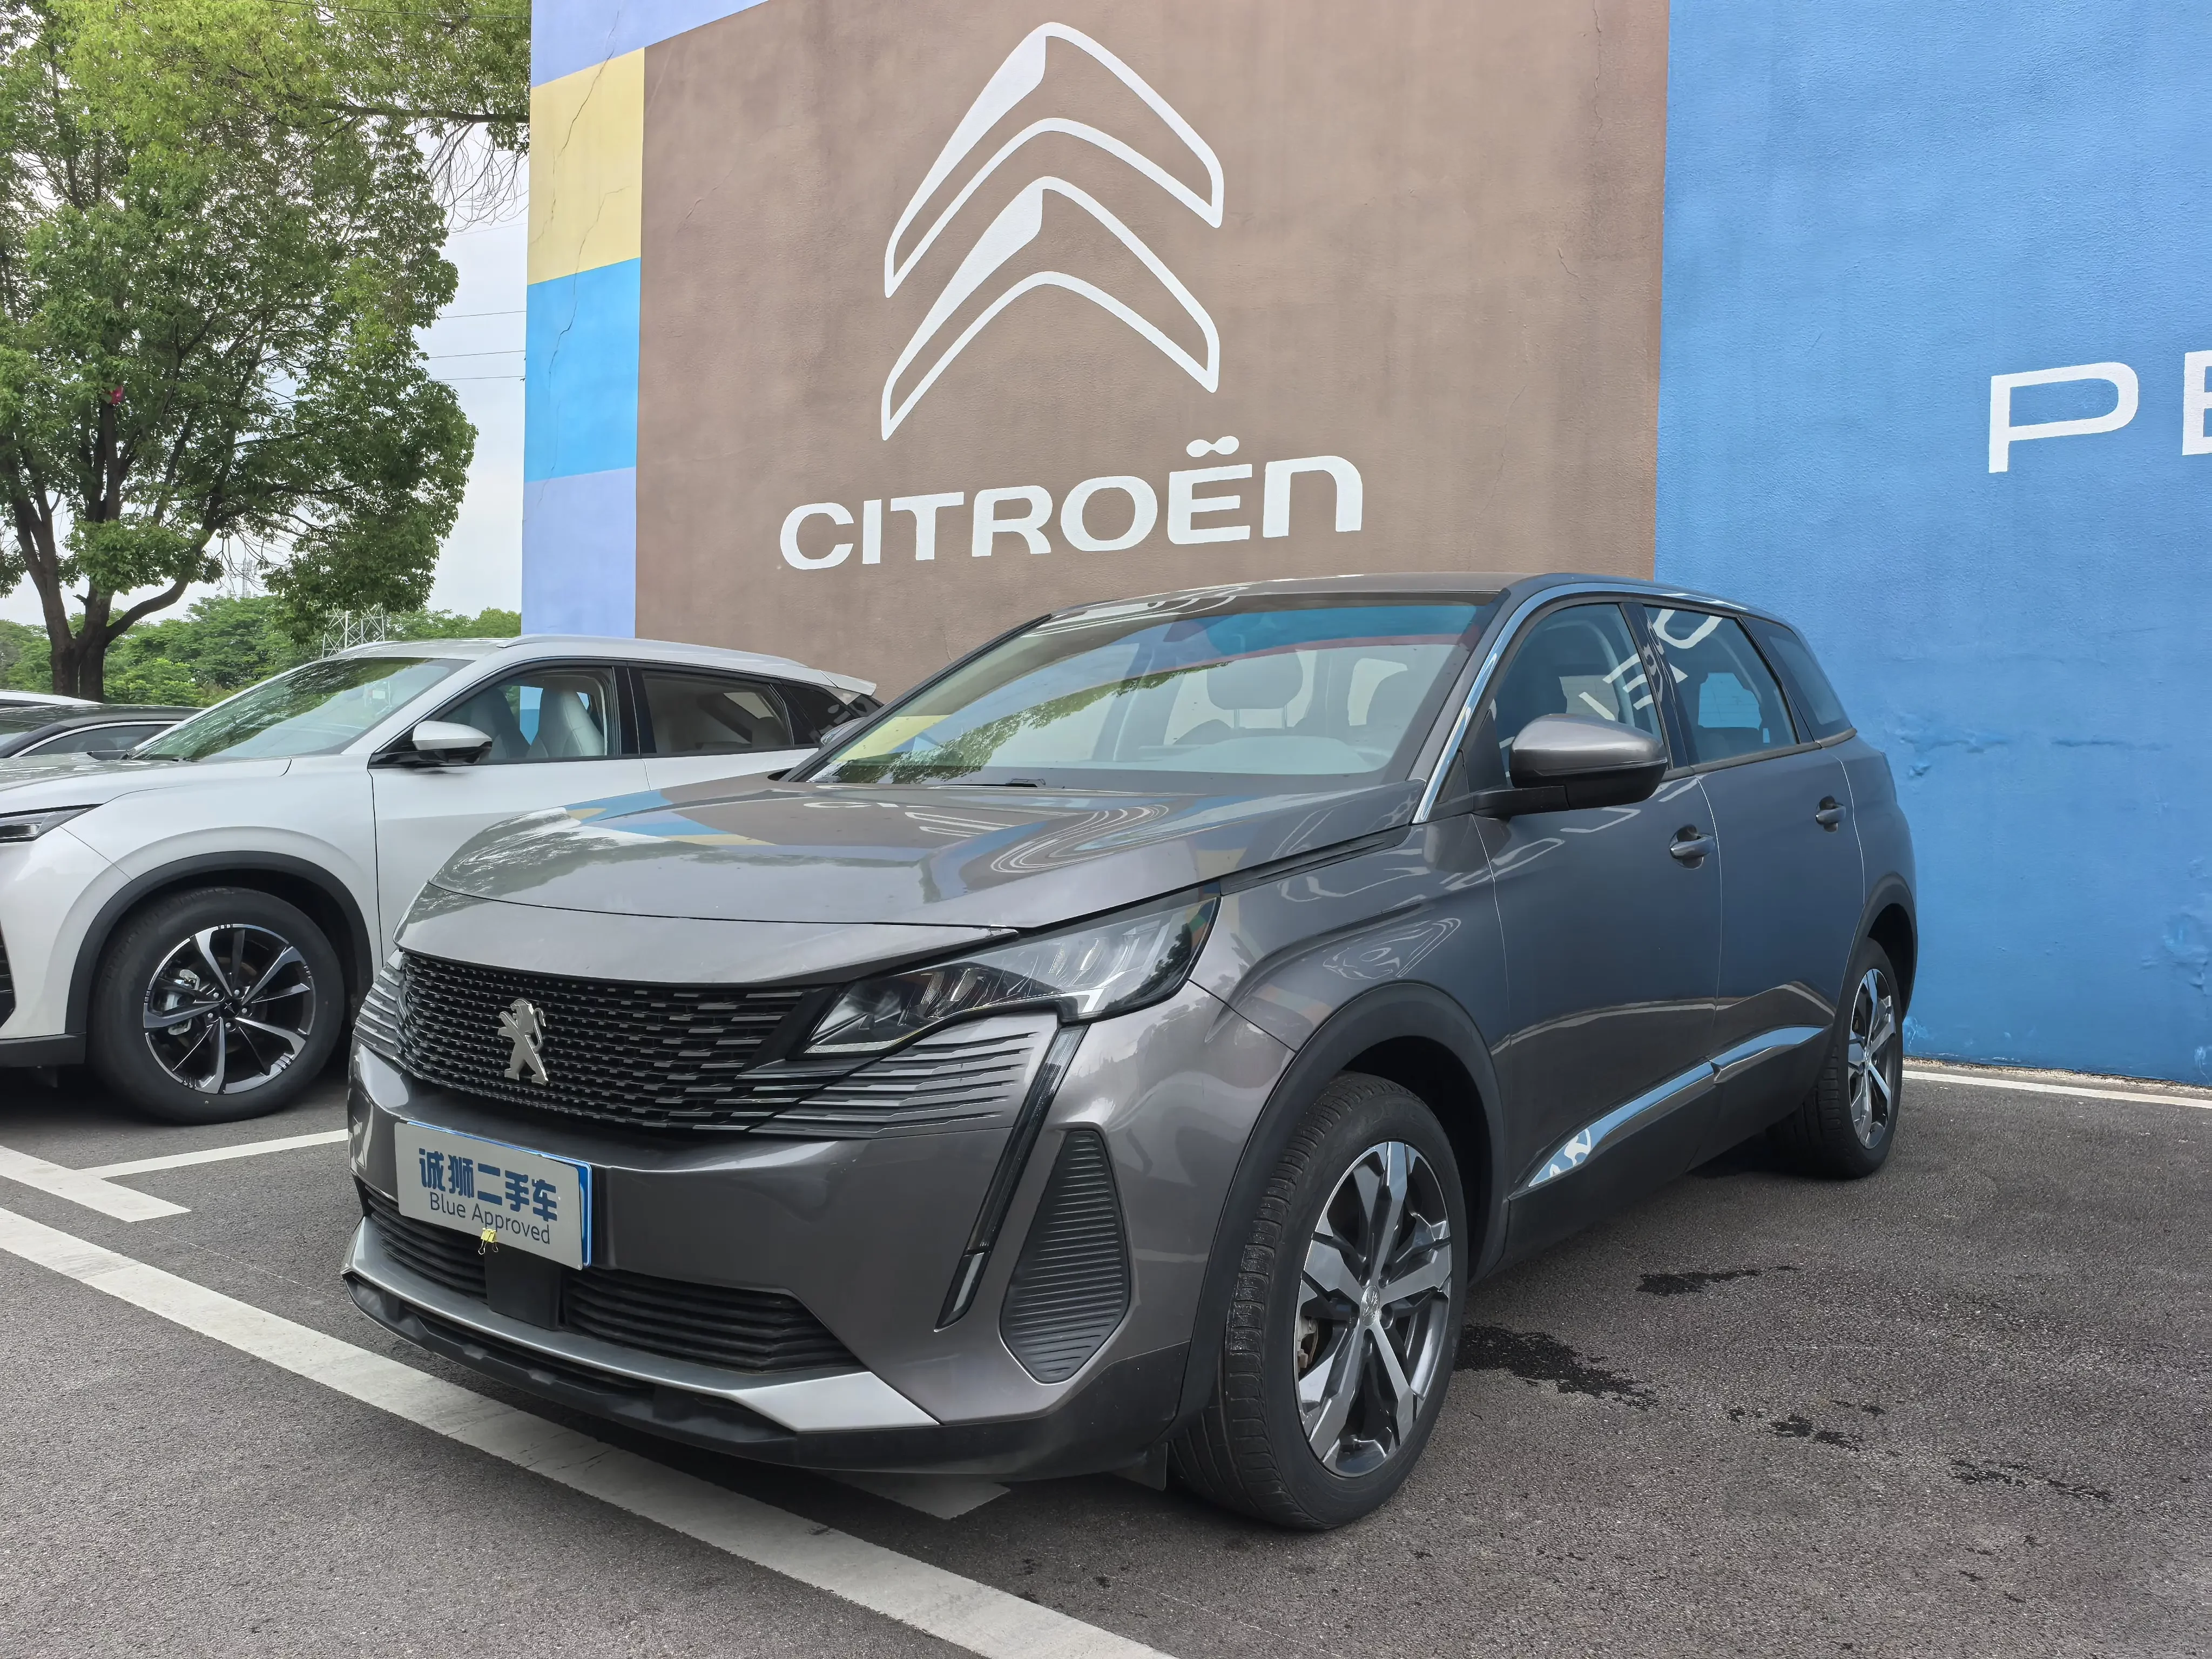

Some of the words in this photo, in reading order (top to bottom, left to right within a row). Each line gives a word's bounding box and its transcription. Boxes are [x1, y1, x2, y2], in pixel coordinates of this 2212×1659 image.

[419, 1148, 558, 1222] 诚狮二手车
[430, 1192, 467, 1218] Blue
[471, 1203, 550, 1245] Approved
